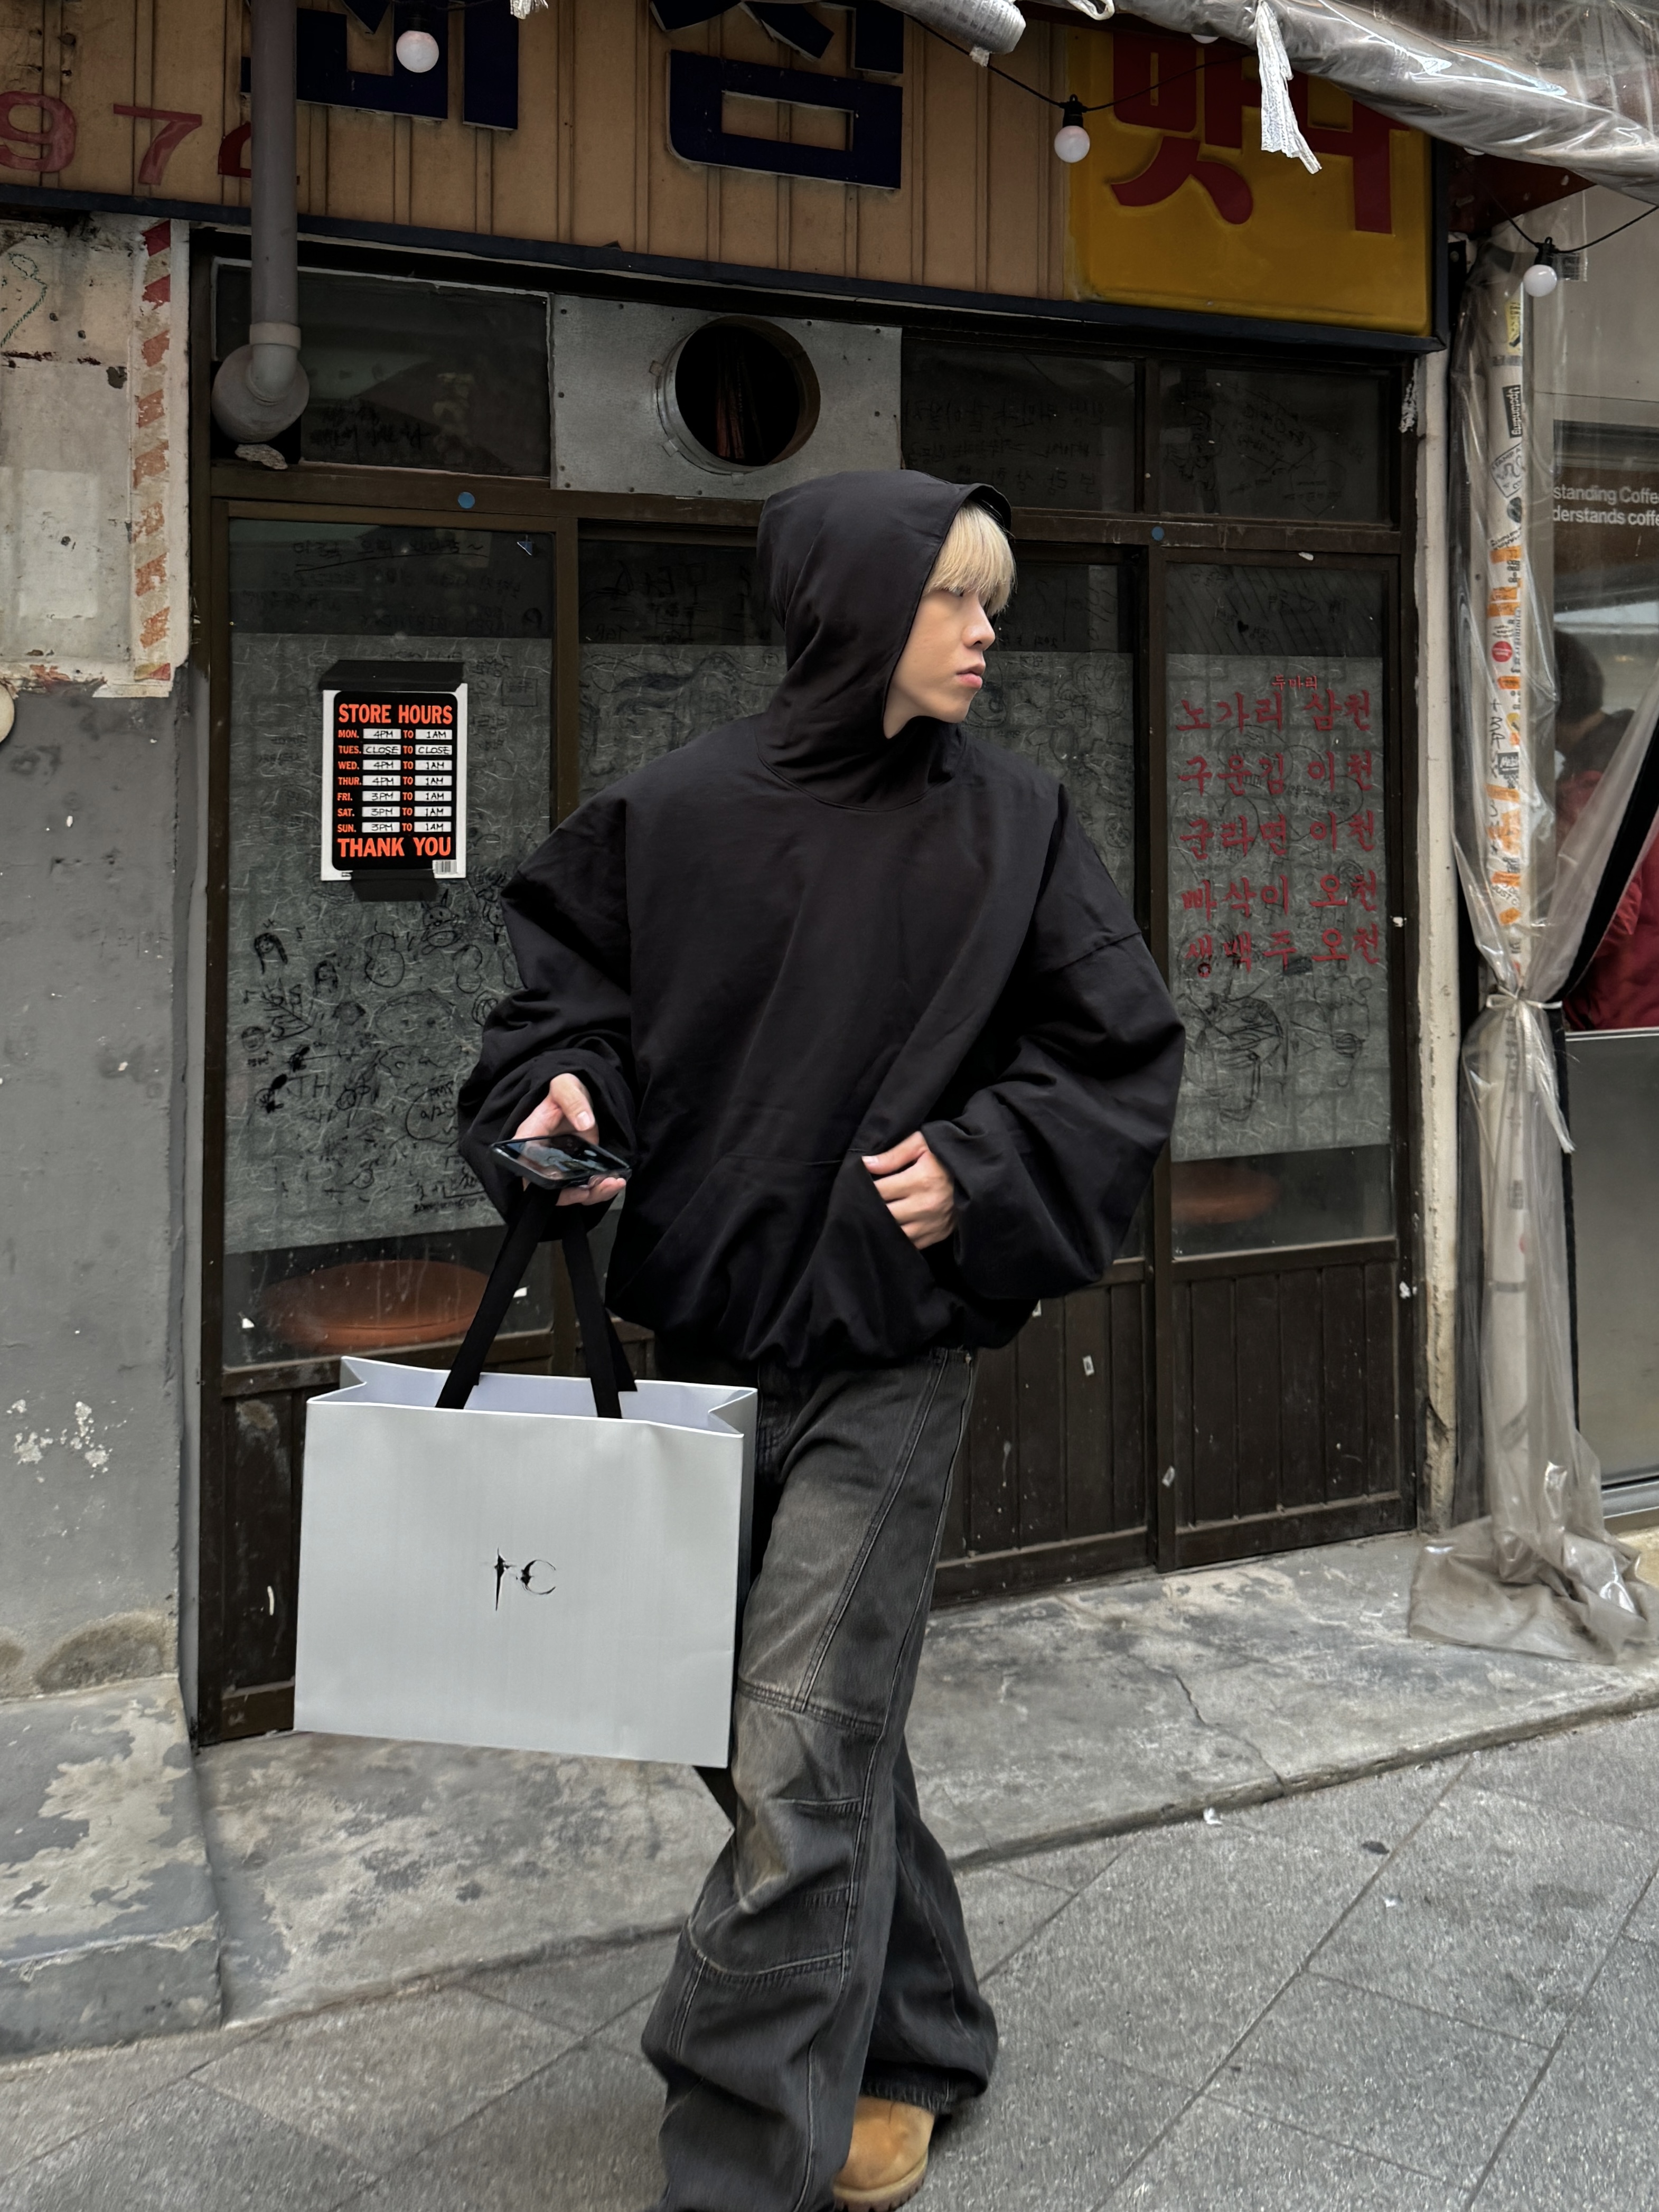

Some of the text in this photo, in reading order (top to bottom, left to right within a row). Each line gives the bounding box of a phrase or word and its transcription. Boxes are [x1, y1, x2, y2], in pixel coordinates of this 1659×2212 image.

[1271, 674, 1318, 692] 두마리
[339, 704, 391, 723] STORE
[398, 705, 453, 725] HOURS
[1176, 688, 1371, 734] 노가리 삼천
[338, 729, 359, 738] MON.
[373, 730, 393, 739] 4PM
[403, 730, 414, 738] TO
[338, 745, 451, 755] TUES. CLOSE TO CLOSE
[338, 761, 360, 770] WED.
[402, 761, 414, 770] TO
[1178, 749, 1373, 796] 구운김 이천
[338, 776, 362, 785] THUR.
[372, 777, 393, 786] 4PM
[402, 776, 414, 785] TO
[337, 792, 353, 801] FRI.
[371, 792, 393, 801] 3PM
[402, 792, 413, 801] TO
[337, 808, 355, 817] SAT.
[402, 808, 413, 816] TO
[426, 808, 444, 817] 1AM
[337, 824, 357, 832] SUN.
[371, 823, 393, 832] 3PM
[402, 823, 413, 831] TO
[1309, 809, 1375, 852] 이천
[338, 837, 451, 857] THANK YOU
[1181, 869, 1377, 922] 빠삭이 오천
[1185, 923, 1380, 978] 생맥주 오천
